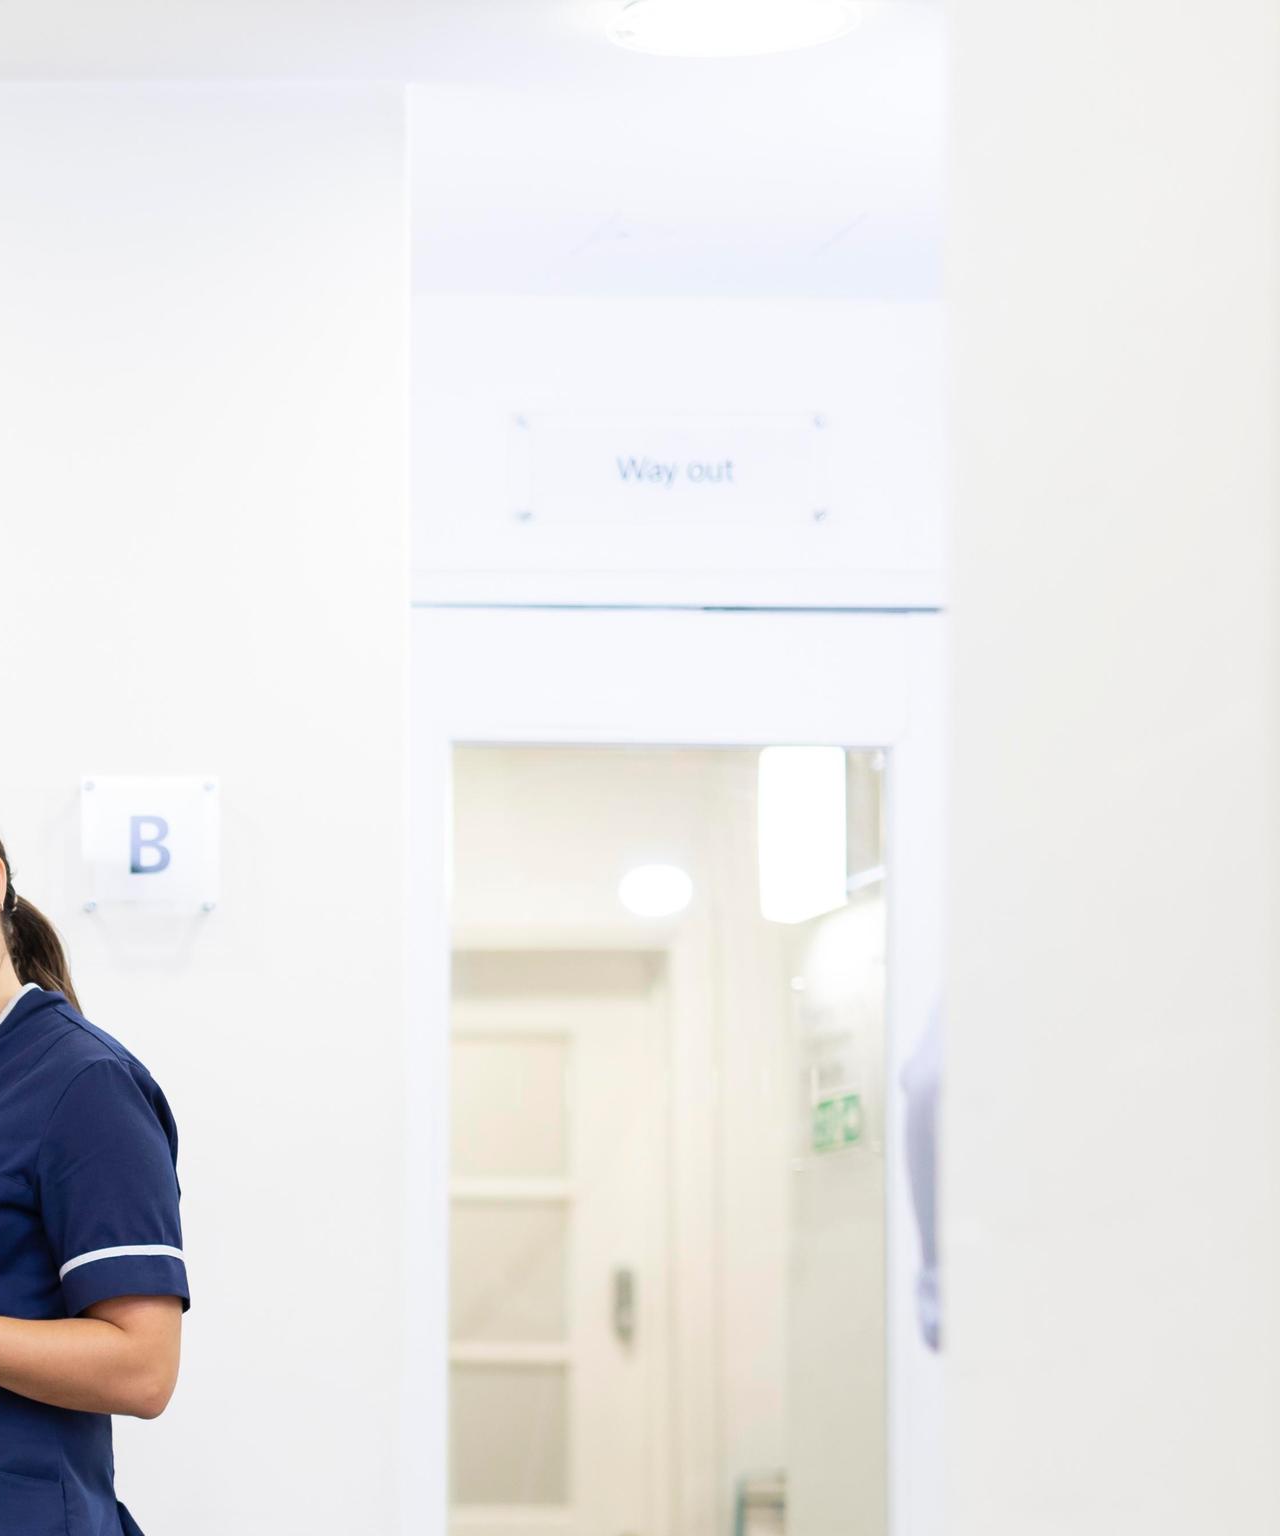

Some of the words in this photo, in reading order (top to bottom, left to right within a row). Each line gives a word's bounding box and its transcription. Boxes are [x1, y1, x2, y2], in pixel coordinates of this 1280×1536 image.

[616, 455, 677, 490] Way
[686, 459, 734, 483] out
[129, 814, 171, 875] B
